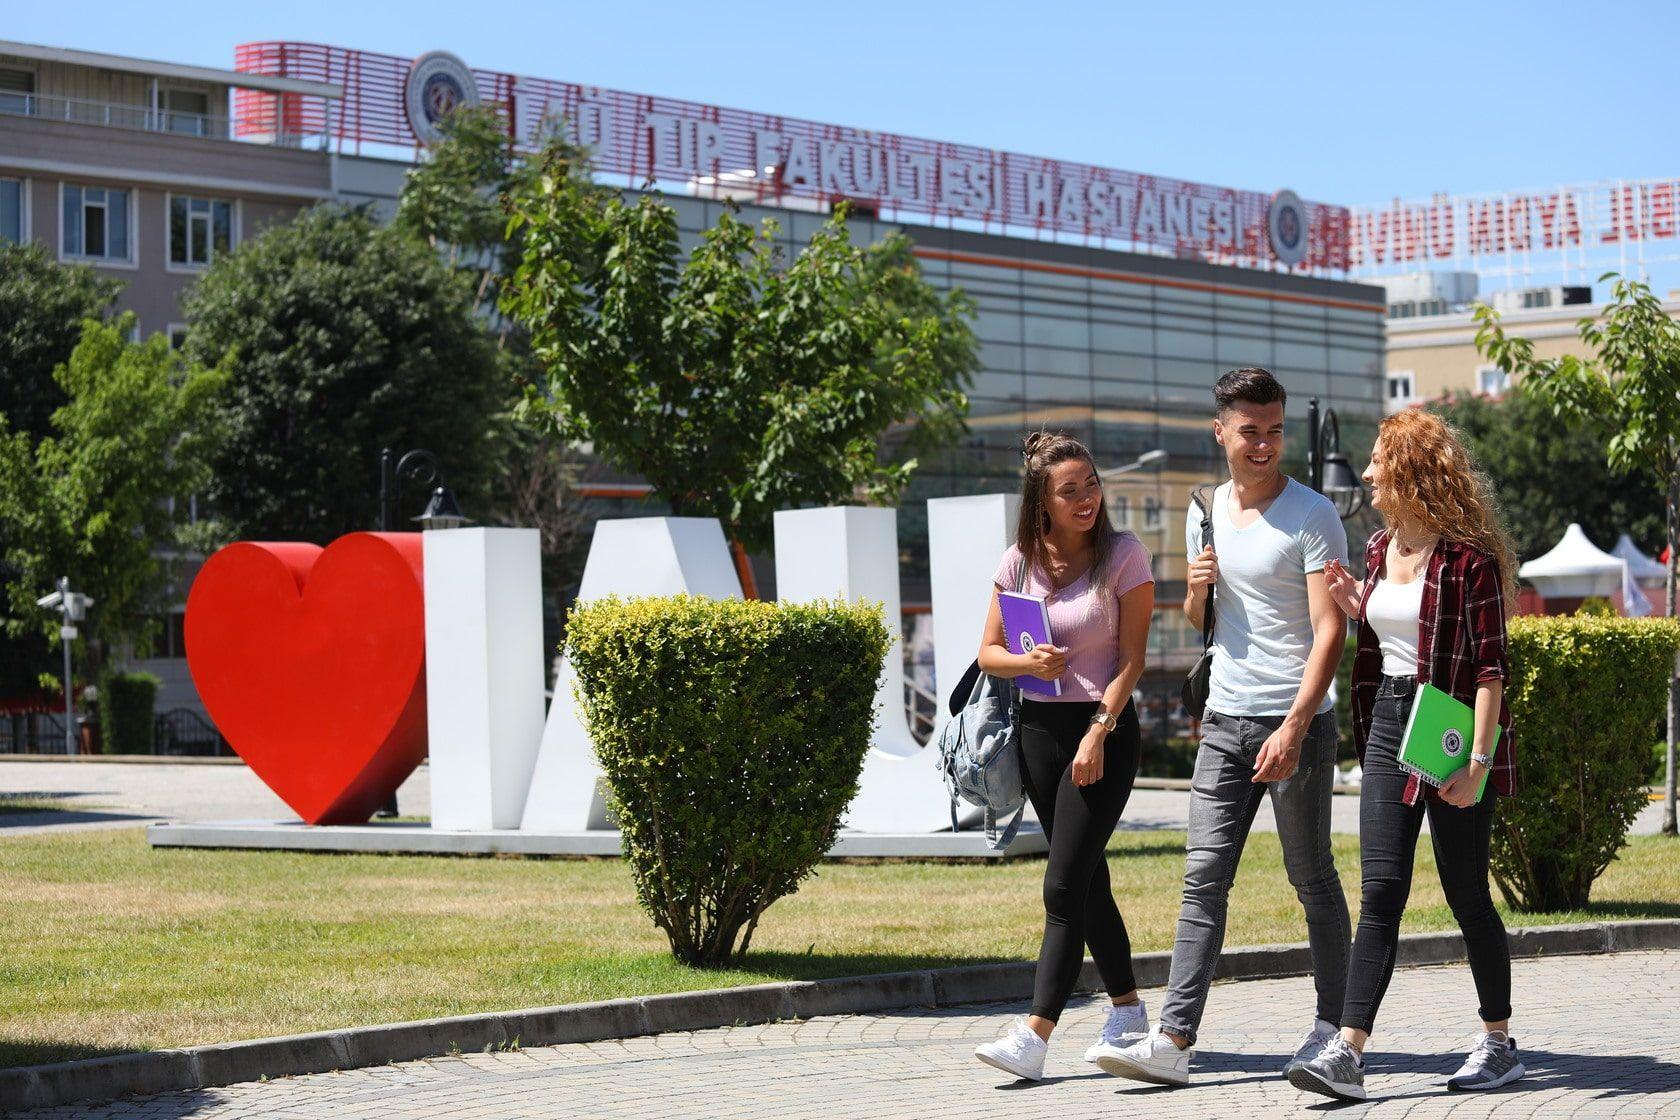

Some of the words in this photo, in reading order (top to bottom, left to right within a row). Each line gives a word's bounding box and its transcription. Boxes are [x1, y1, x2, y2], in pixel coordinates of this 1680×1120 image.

[643, 110, 724, 178] TIP
[755, 127, 1004, 211] FAKÜLTESİ
[1024, 169, 1246, 250] HASTANESİ
